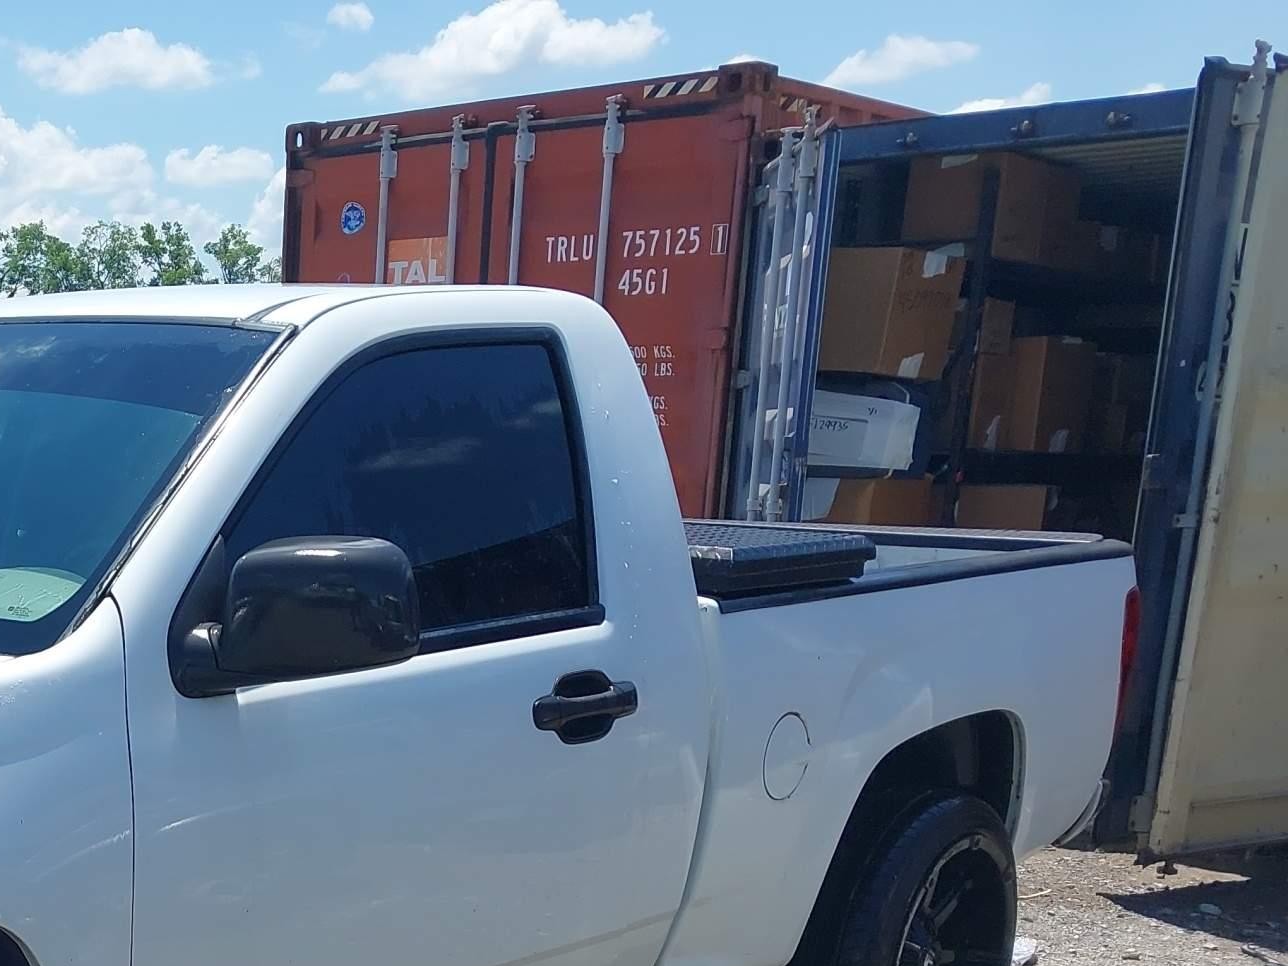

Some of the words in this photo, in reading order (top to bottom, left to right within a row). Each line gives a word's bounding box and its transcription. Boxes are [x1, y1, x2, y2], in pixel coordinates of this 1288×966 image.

[545, 234, 594, 264] TRLU
[622, 226, 701, 258] 757125
[388, 257, 447, 284] TAL
[618, 268, 669, 296] 45G1
[653, 345, 675, 359] KGS.
[654, 362, 675, 376] LBS.
